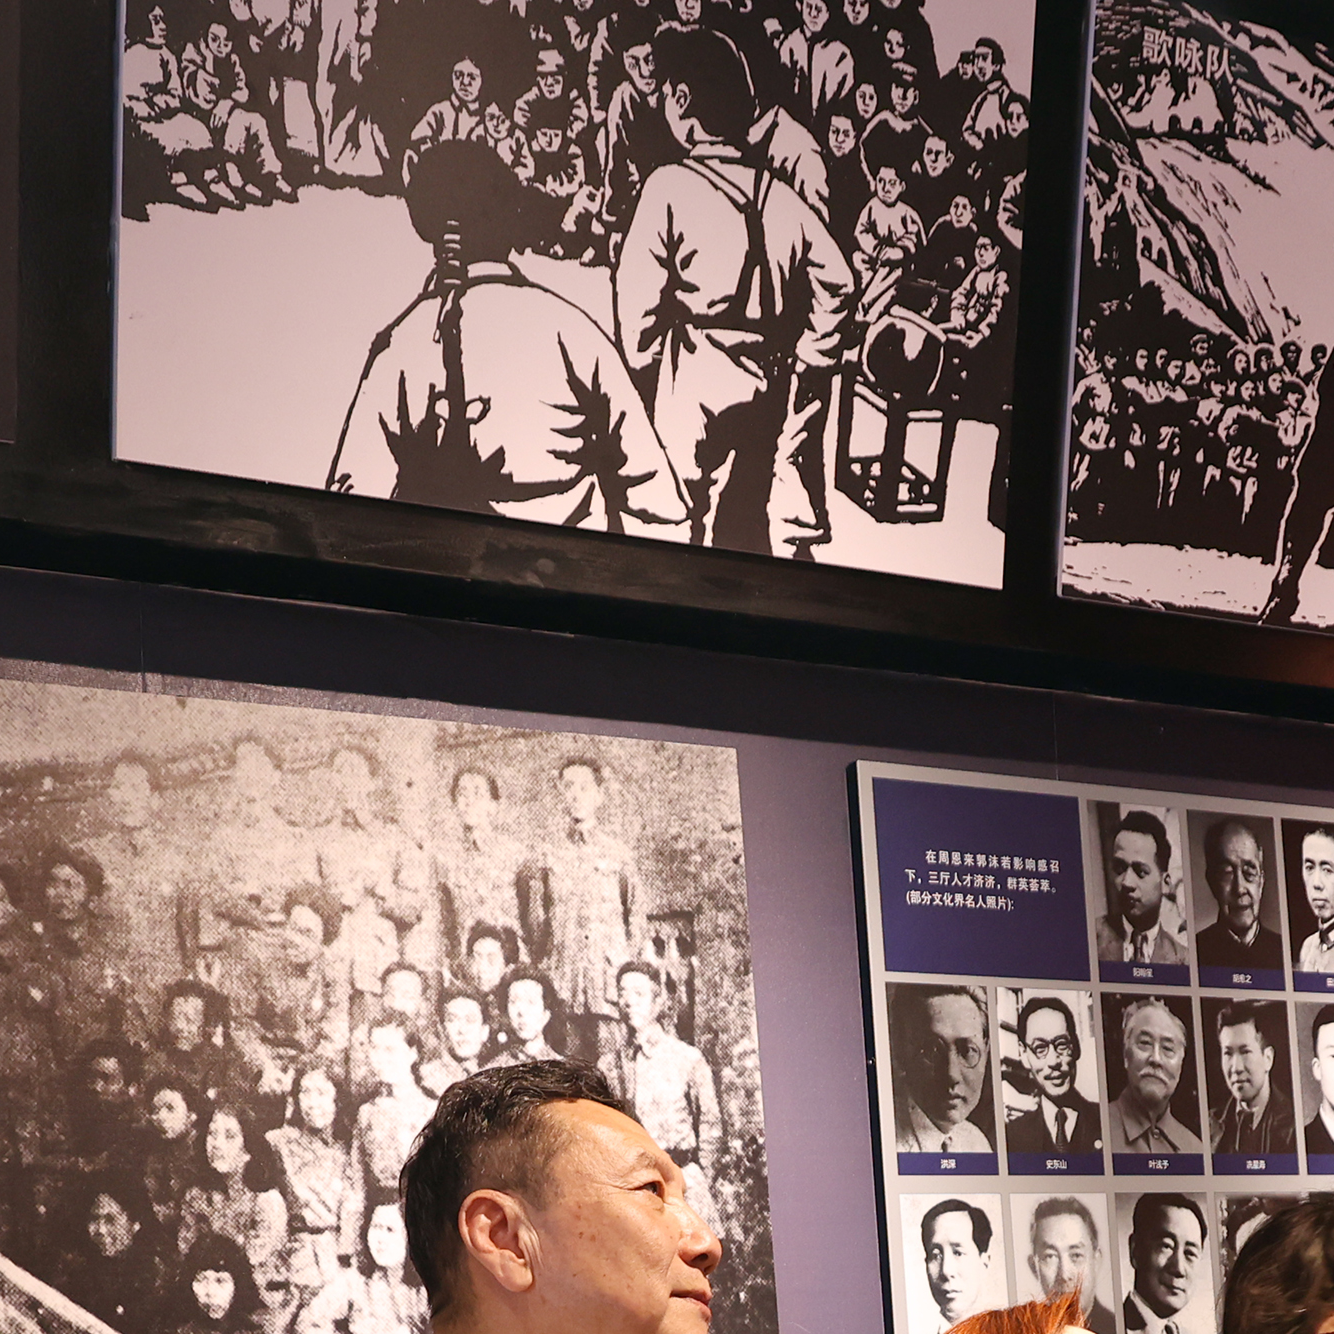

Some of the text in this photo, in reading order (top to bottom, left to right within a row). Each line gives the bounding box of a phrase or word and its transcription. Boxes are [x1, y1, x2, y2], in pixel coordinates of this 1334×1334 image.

[1142, 26, 1234, 84] 歌咏队
[925, 849, 1061, 873] 在周恩来郭沫若影响感召
